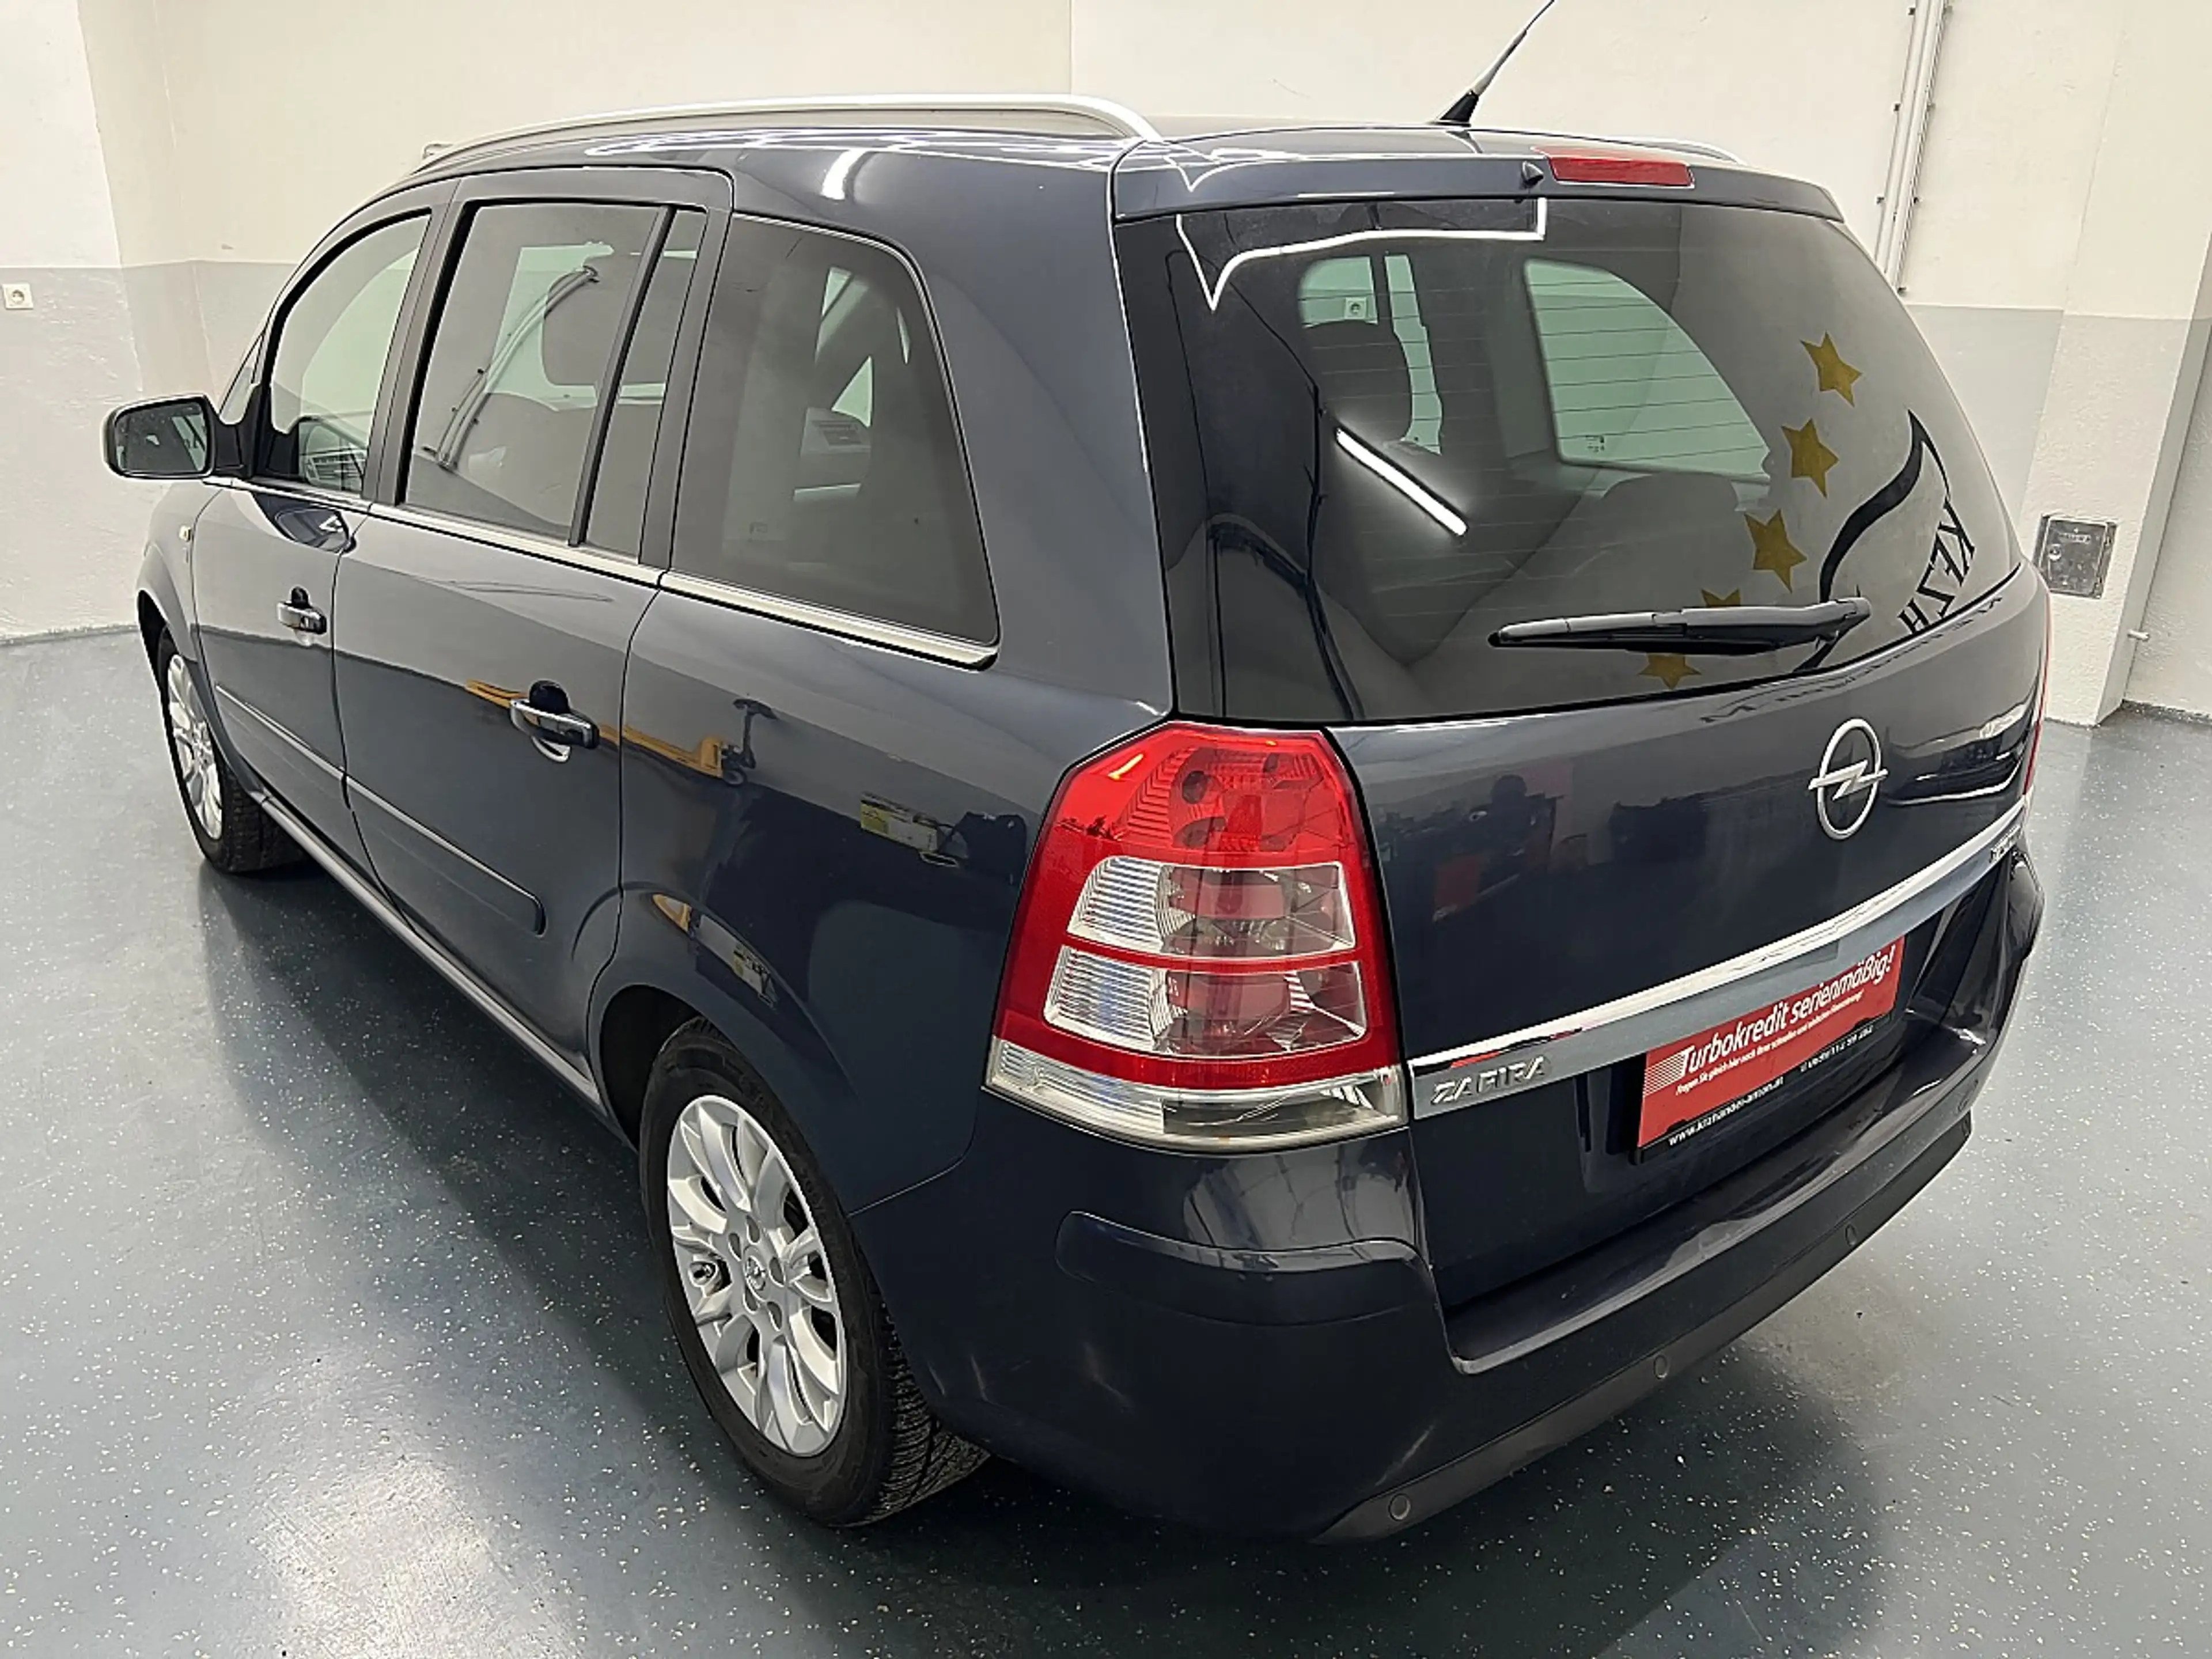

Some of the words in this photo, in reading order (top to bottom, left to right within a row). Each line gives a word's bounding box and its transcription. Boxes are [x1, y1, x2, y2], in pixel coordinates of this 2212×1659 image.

[1680, 1001, 1790, 1077] Turbokredit
[1790, 944, 1896, 1024] serienmäßig!
[1431, 1055, 1550, 1105] ZAFIRA
